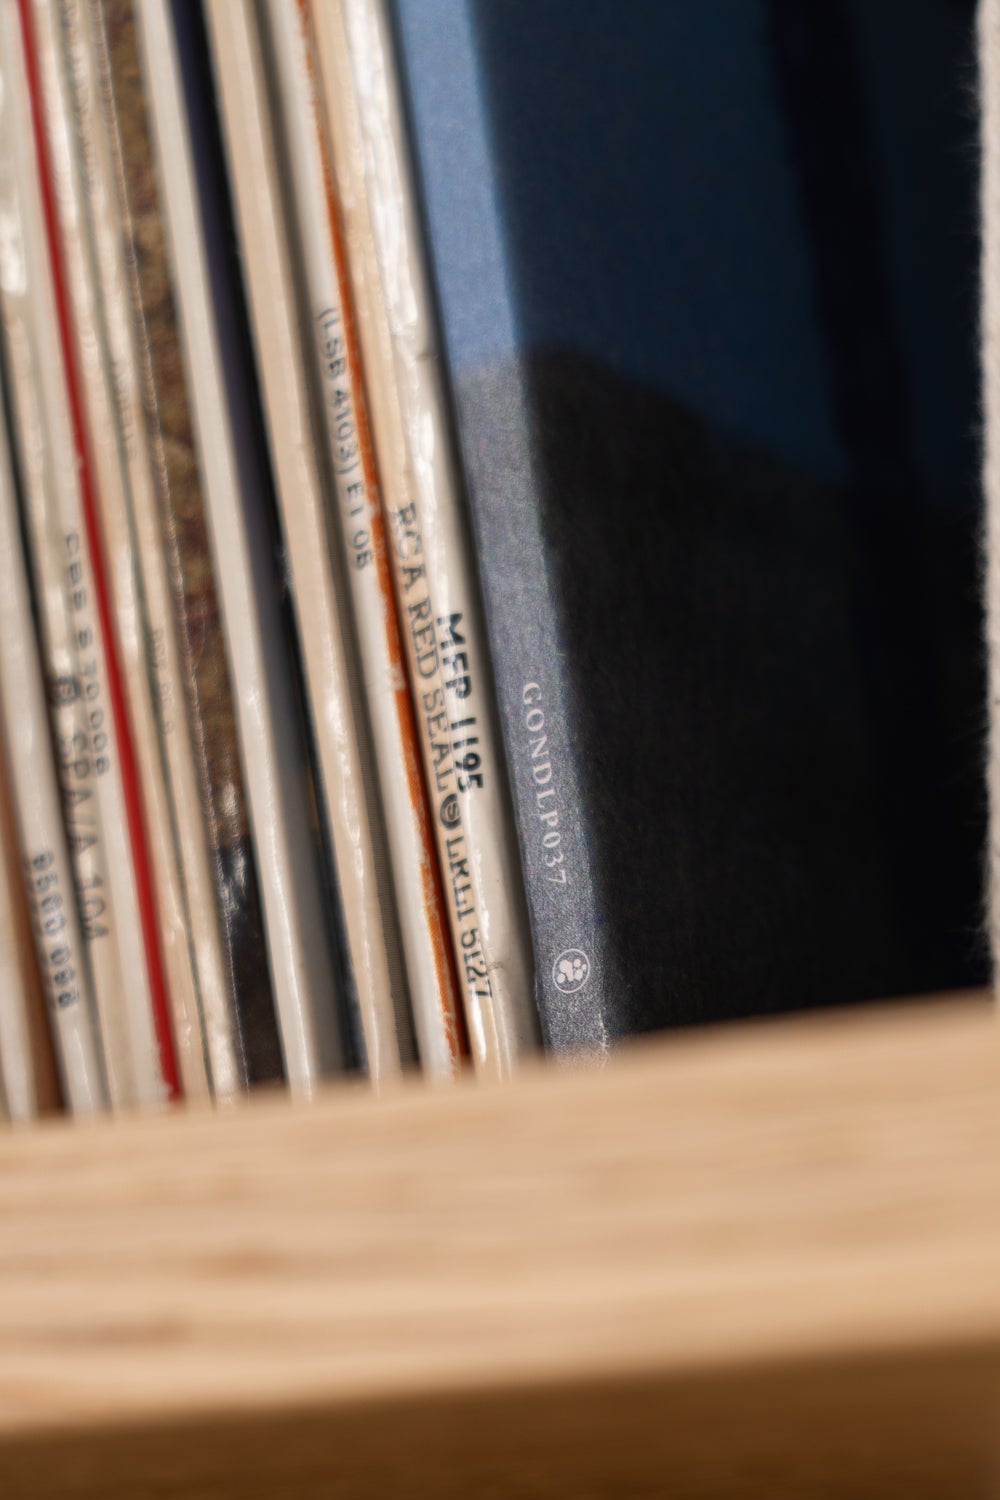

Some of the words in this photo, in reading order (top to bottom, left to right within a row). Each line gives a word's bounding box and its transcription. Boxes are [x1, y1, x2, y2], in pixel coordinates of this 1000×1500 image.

[388, 501, 427, 591] RCA
[404, 598, 441, 679] RED
[435, 611, 473, 701] MFP
[420, 689, 455, 794] SEAL
[450, 716, 484, 793] 1195
[520, 680, 567, 885] GONDLP037
